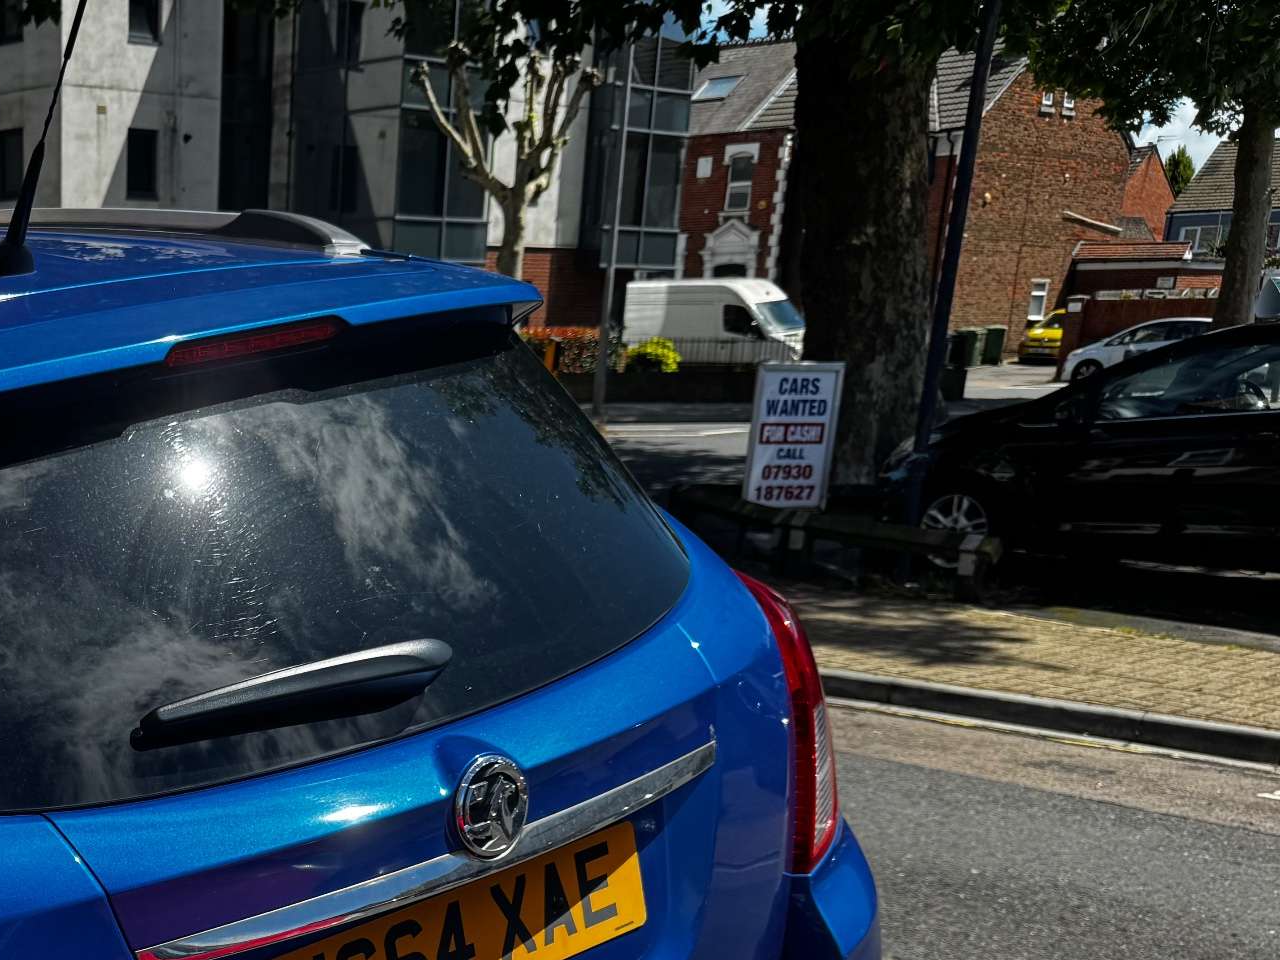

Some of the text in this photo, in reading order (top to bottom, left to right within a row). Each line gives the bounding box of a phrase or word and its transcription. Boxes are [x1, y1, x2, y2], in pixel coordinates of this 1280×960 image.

[778, 377, 821, 396] CARS
[765, 400, 827, 417] WANTED
[762, 426, 786, 442] FOR
[776, 448, 805, 460] CALL
[761, 464, 813, 480] 07930
[754, 485, 815, 501] 187627
